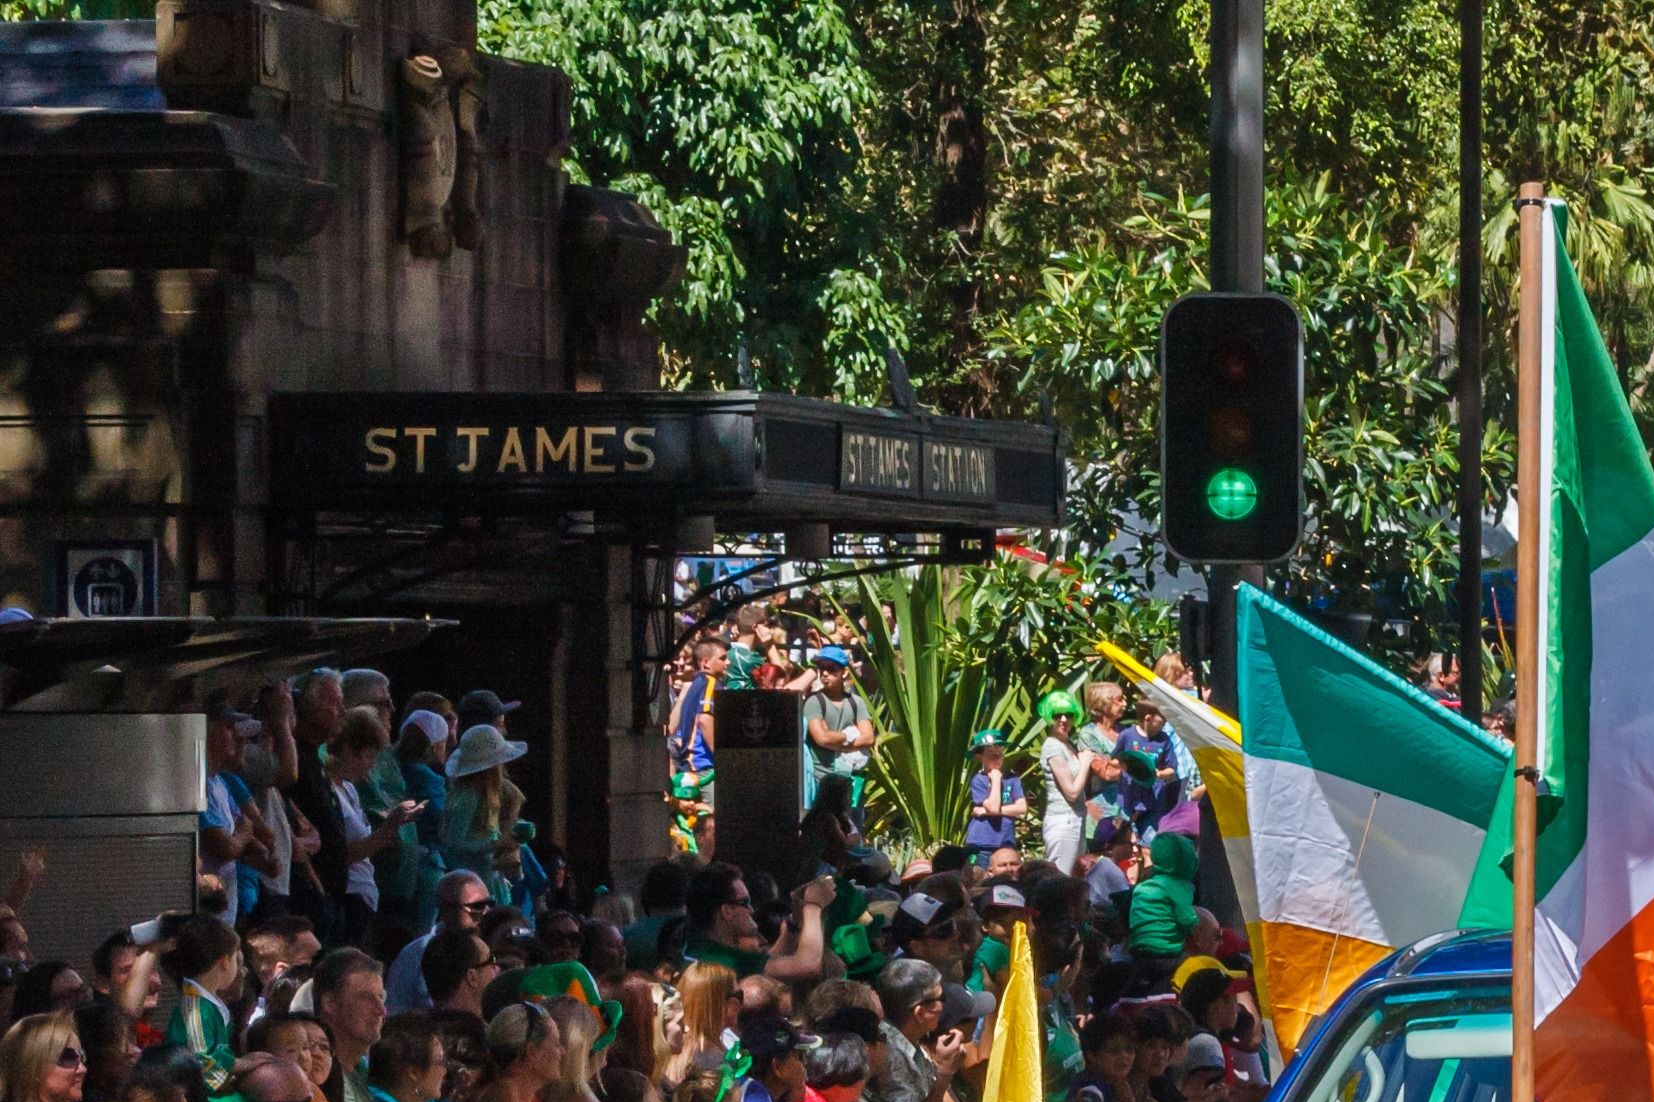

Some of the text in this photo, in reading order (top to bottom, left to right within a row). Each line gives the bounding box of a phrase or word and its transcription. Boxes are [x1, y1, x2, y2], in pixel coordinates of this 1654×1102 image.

[365, 426, 656, 473] ST JAMES
[848, 434, 986, 496] ST JAMES STATION
